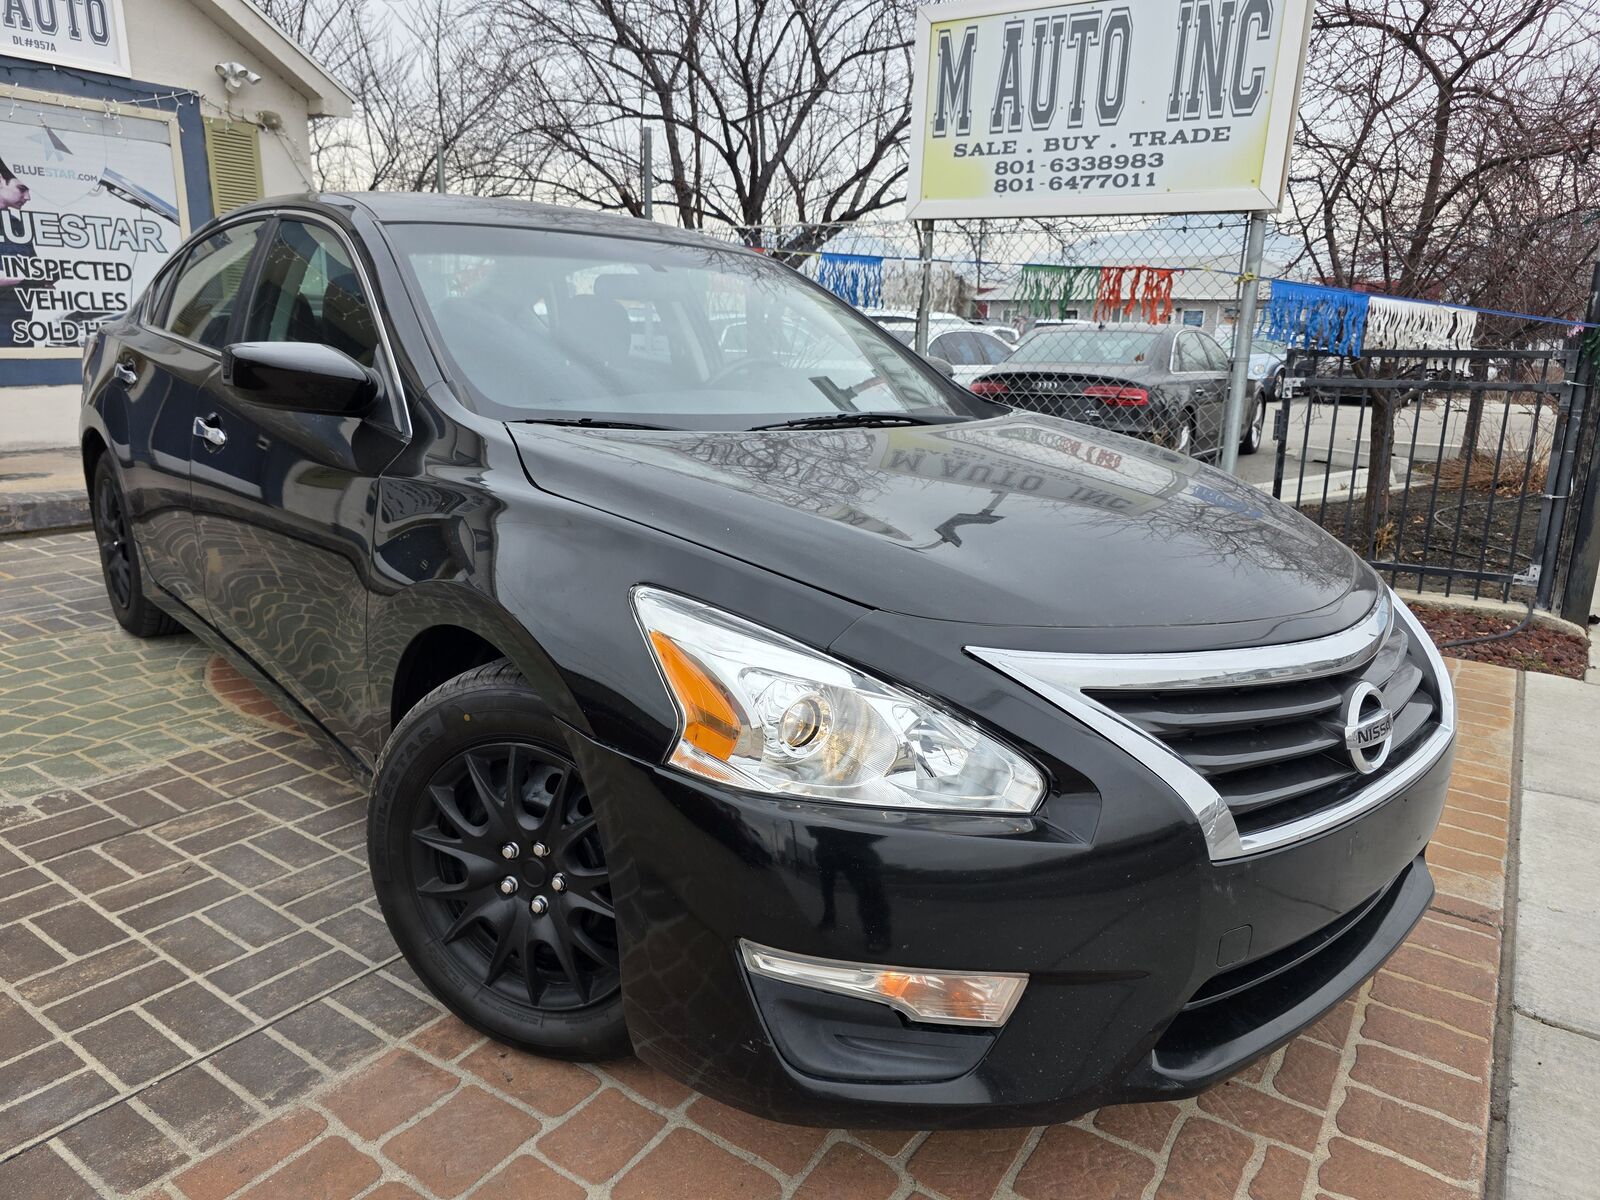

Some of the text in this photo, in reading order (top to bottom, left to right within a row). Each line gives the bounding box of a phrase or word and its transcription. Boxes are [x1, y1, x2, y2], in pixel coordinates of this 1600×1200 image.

[3, 0, 110, 46] AUTO
[12, 35, 57, 52] DL#957A
[932, 0, 1273, 138] M AUTO INC
[953, 140, 1017, 158] SALE
[1043, 135, 1100, 153] BUY
[1129, 126, 1232, 147] TRADE
[13, 164, 98, 182] BLUESTAR.COM
[994, 153, 1164, 175] 801-6338983
[994, 173, 1156, 193] 801-6477011
[0, 210, 169, 254] UESTAR
[4, 256, 133, 283] INSPECTED
[17, 289, 128, 312] VEHICLES
[14, 321, 80, 341] SOLD
[1357, 720, 1390, 743] NISSA
